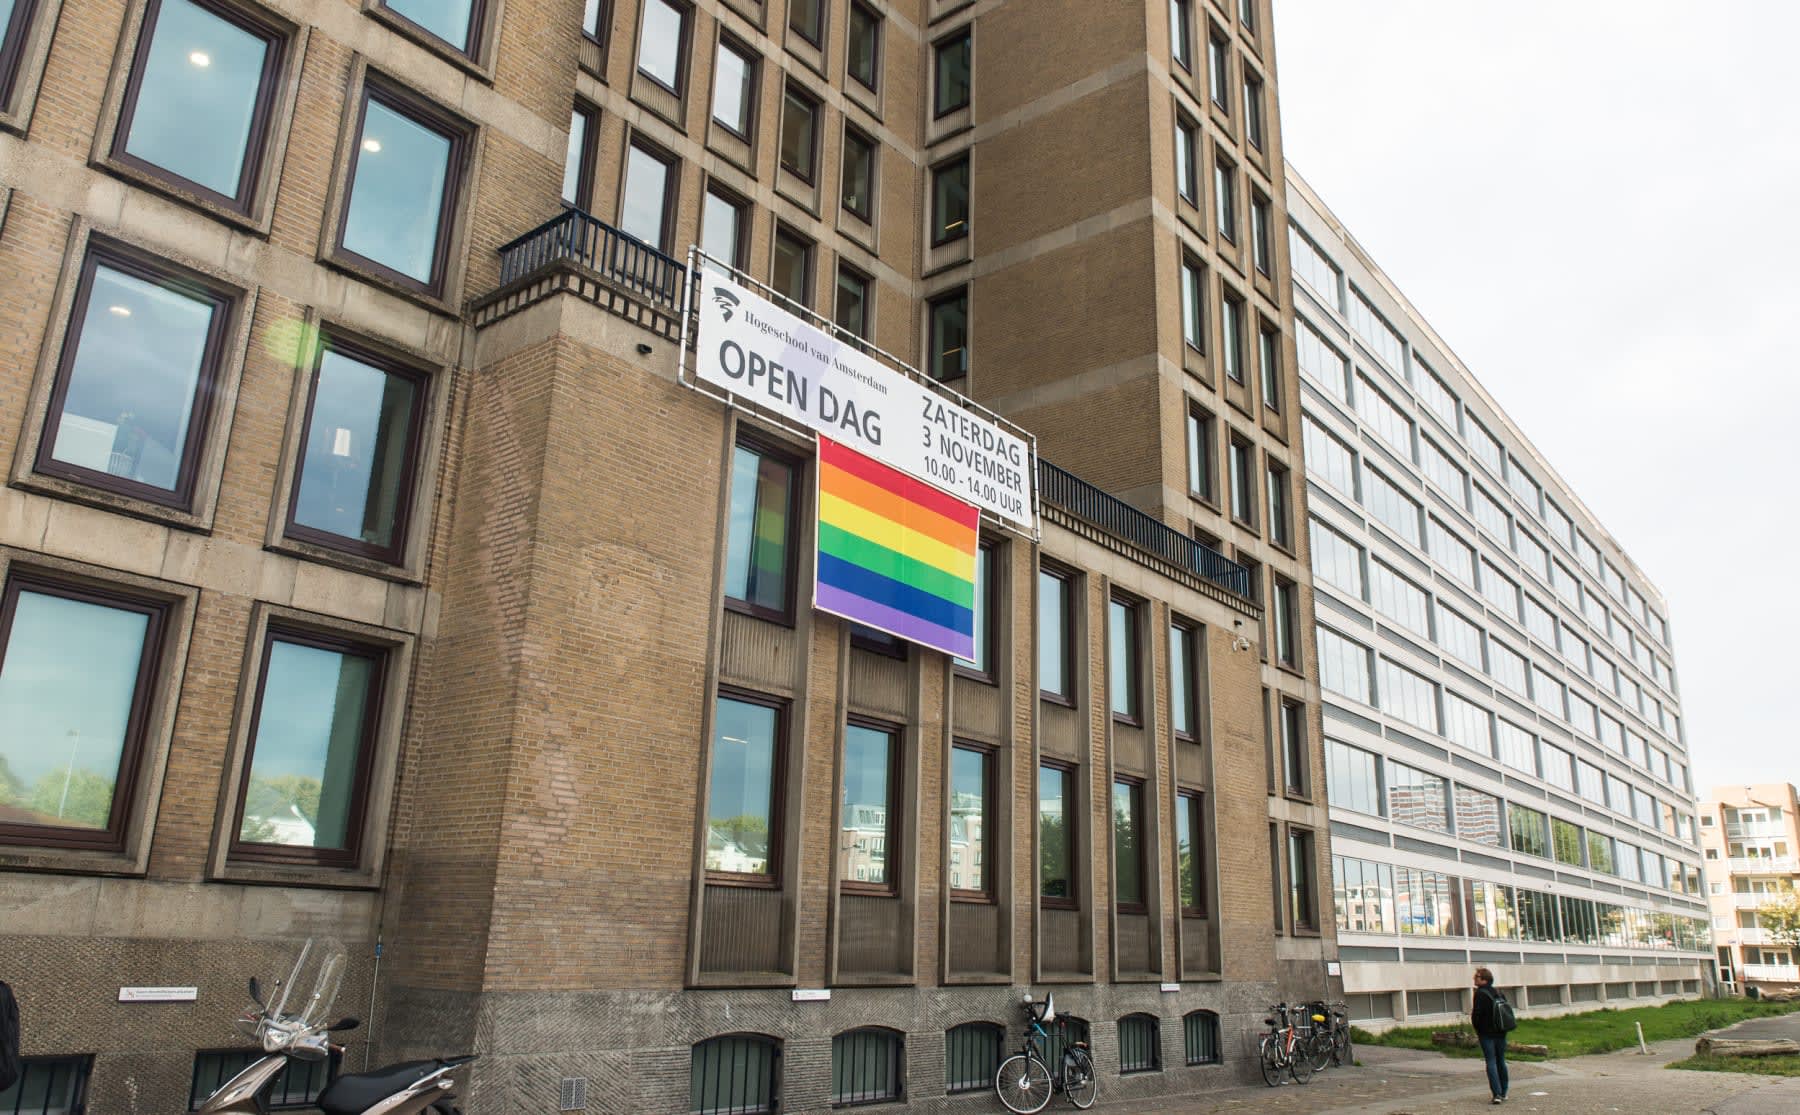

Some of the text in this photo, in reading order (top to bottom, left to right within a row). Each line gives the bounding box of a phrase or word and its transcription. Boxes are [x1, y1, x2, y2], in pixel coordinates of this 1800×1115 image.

[745, 311, 888, 395] Hogeschool van Amsterdam
[720, 340, 881, 446] OPEN DAG
[922, 395, 1020, 467] ZATERDAG
[923, 425, 1022, 494] 3 NOVEMBER
[924, 456, 955, 484] 10.00
[968, 477, 996, 504] 14.00
[1000, 491, 1023, 517] UUR
